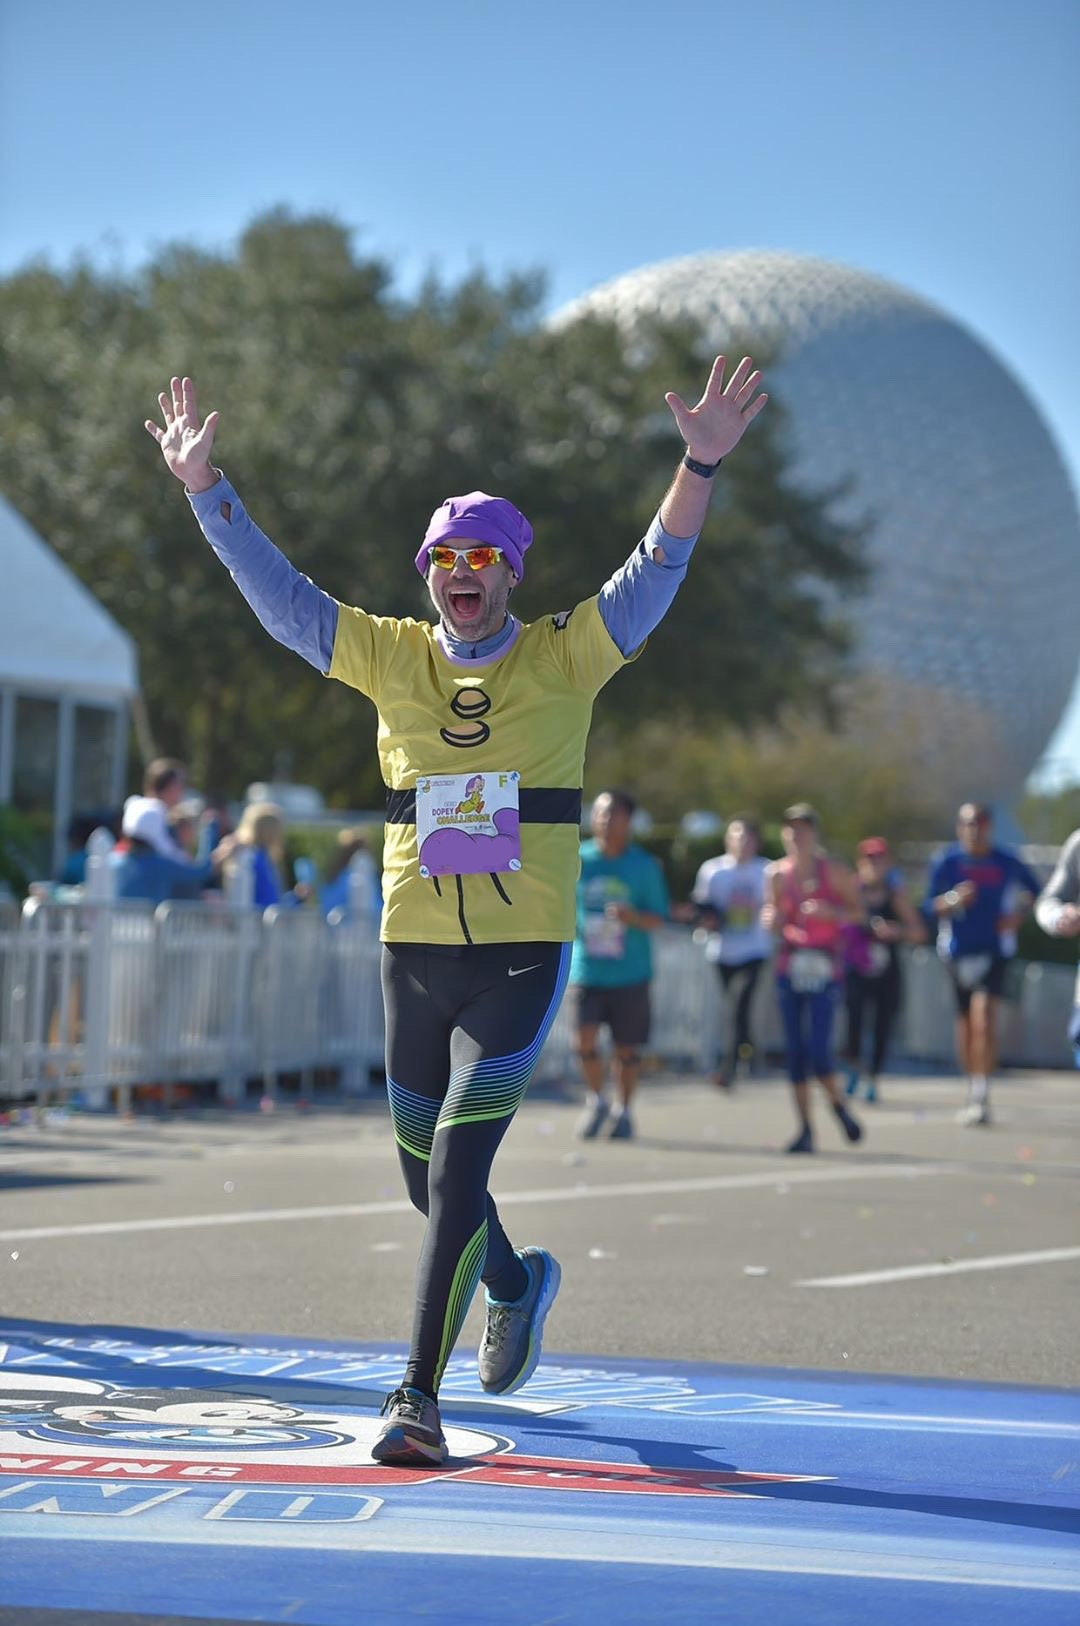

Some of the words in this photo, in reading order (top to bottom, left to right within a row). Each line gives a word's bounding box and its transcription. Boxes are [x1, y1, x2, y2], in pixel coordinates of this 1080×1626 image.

[499, 775, 508, 787] F
[432, 808, 454, 816] DOPEY
[436, 814, 490, 825] CHALLENGE
